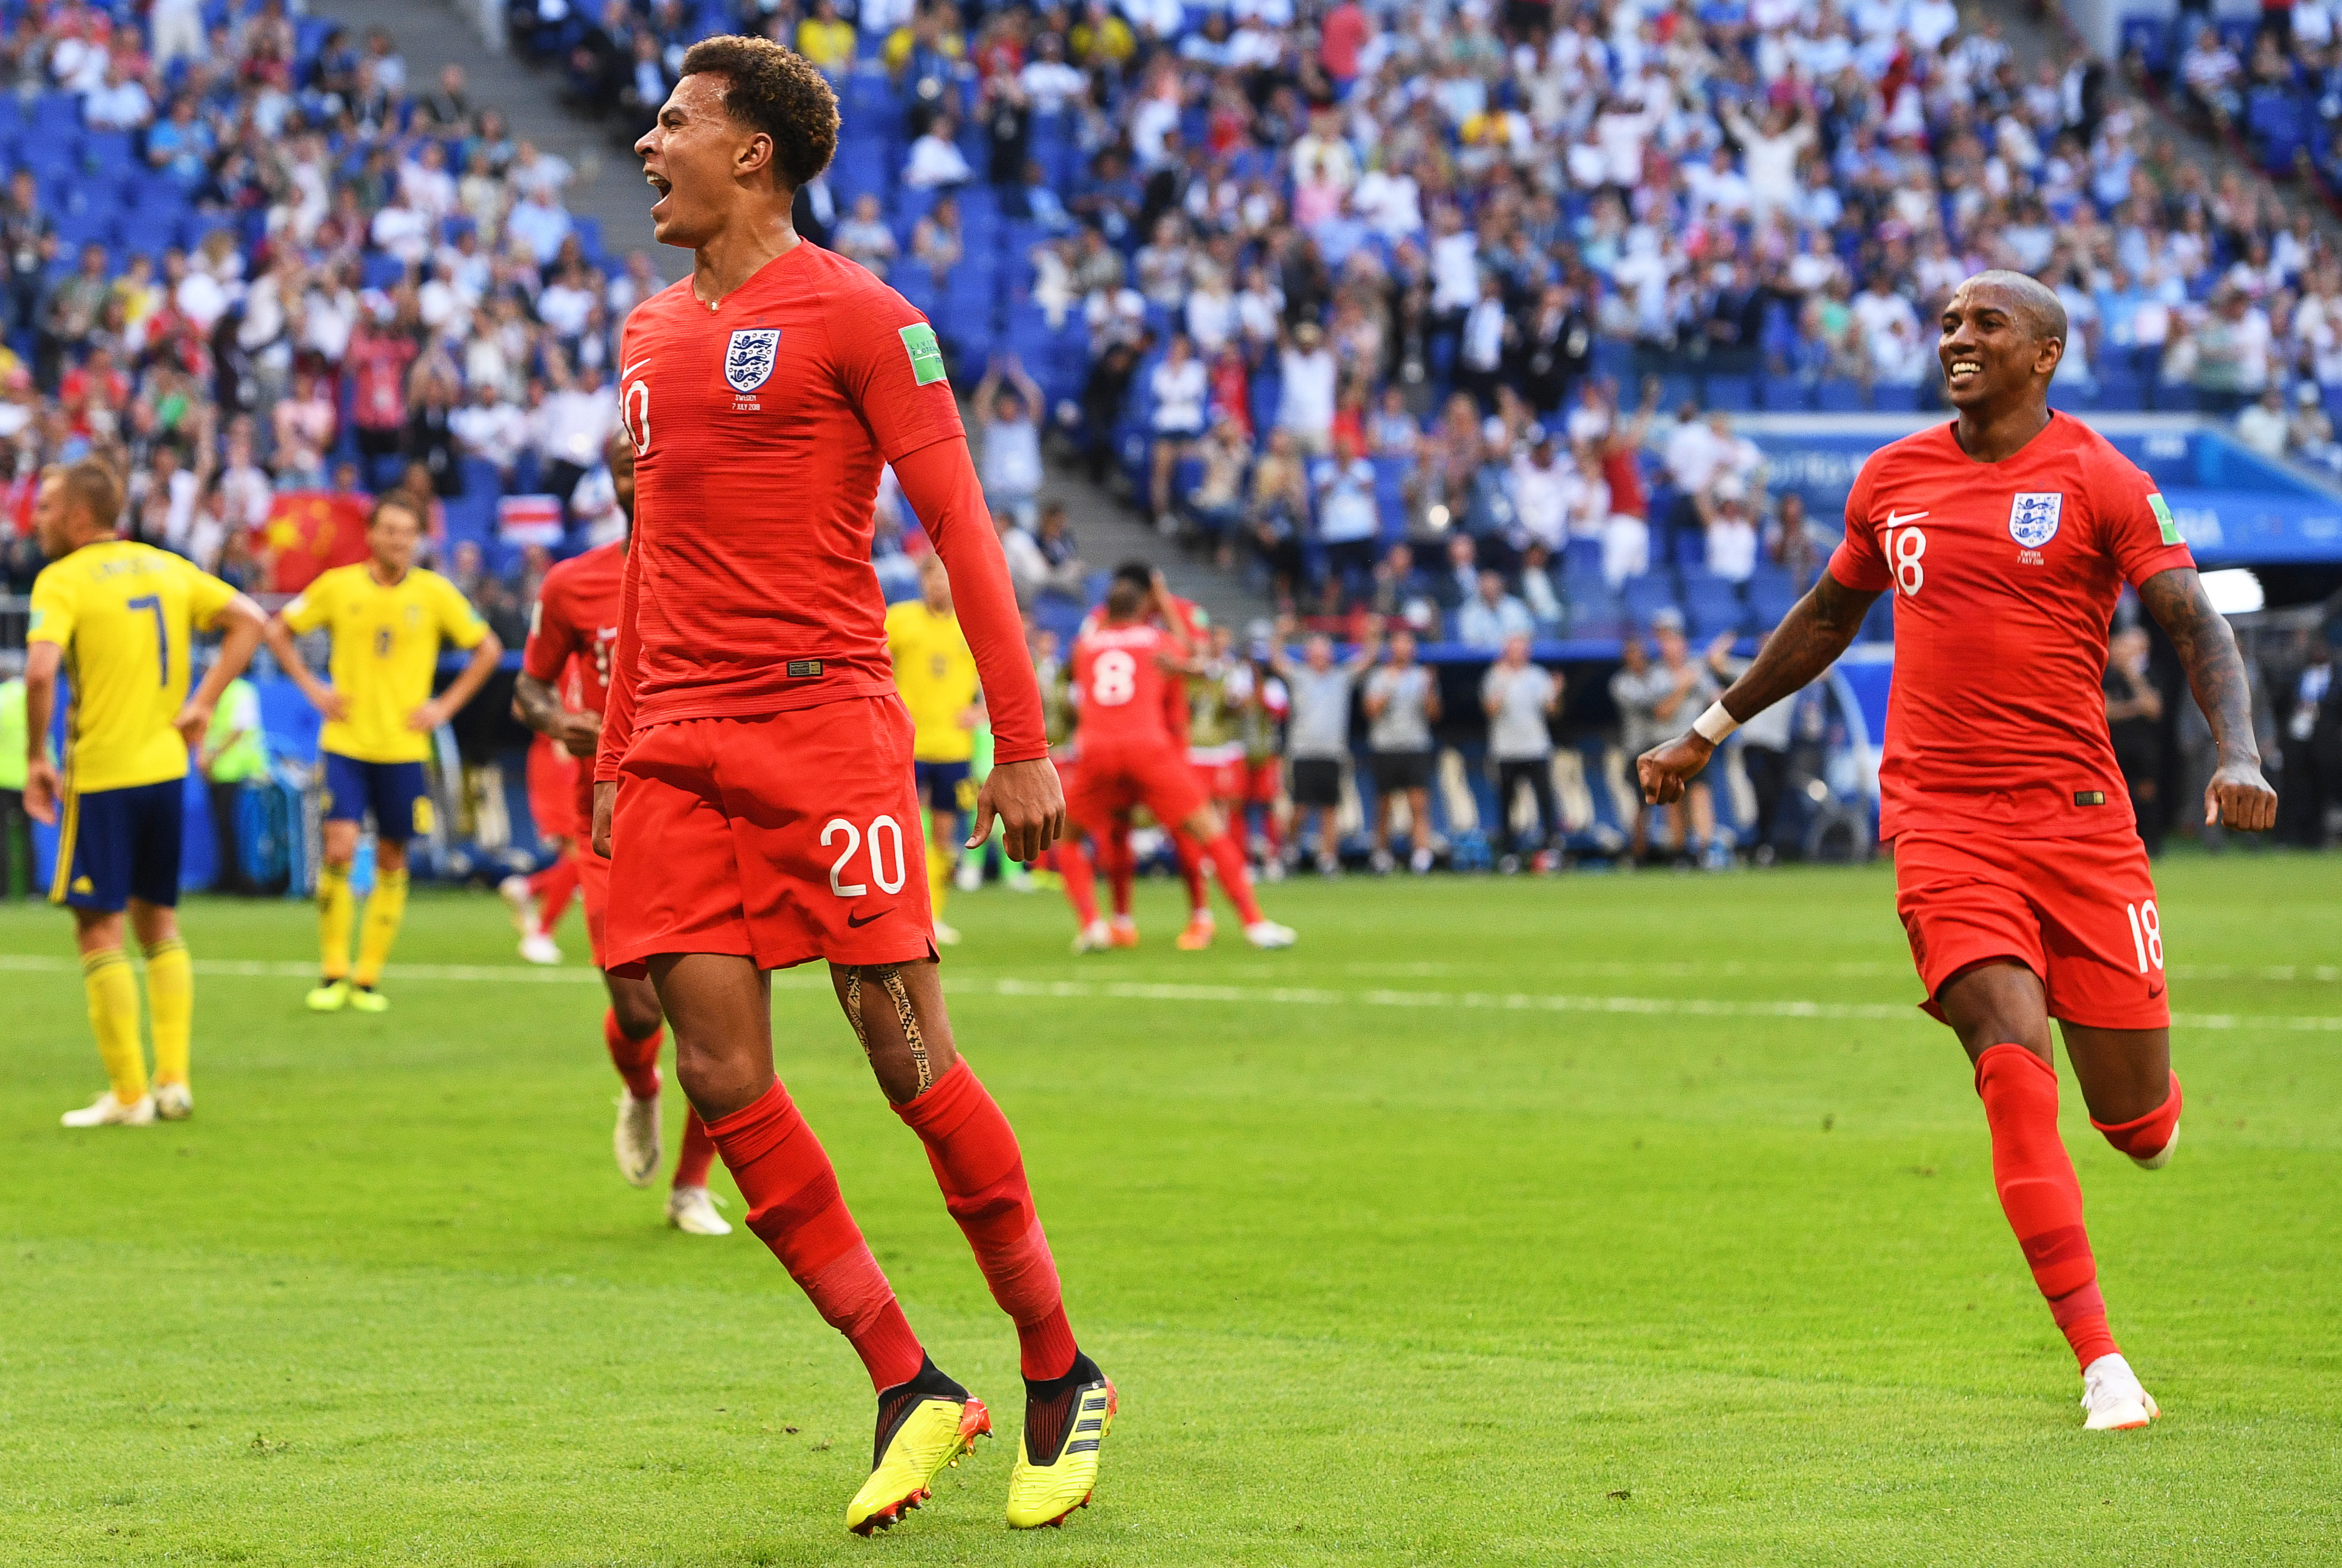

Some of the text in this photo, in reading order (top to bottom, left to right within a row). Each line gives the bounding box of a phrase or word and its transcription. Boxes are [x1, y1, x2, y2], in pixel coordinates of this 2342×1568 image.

[618, 380, 651, 456] 0
[1885, 527, 1926, 596] 18
[127, 595, 168, 688] 7
[1092, 649, 1136, 707] 8
[820, 815, 905, 897] 20
[2127, 899, 2164, 974] 18
